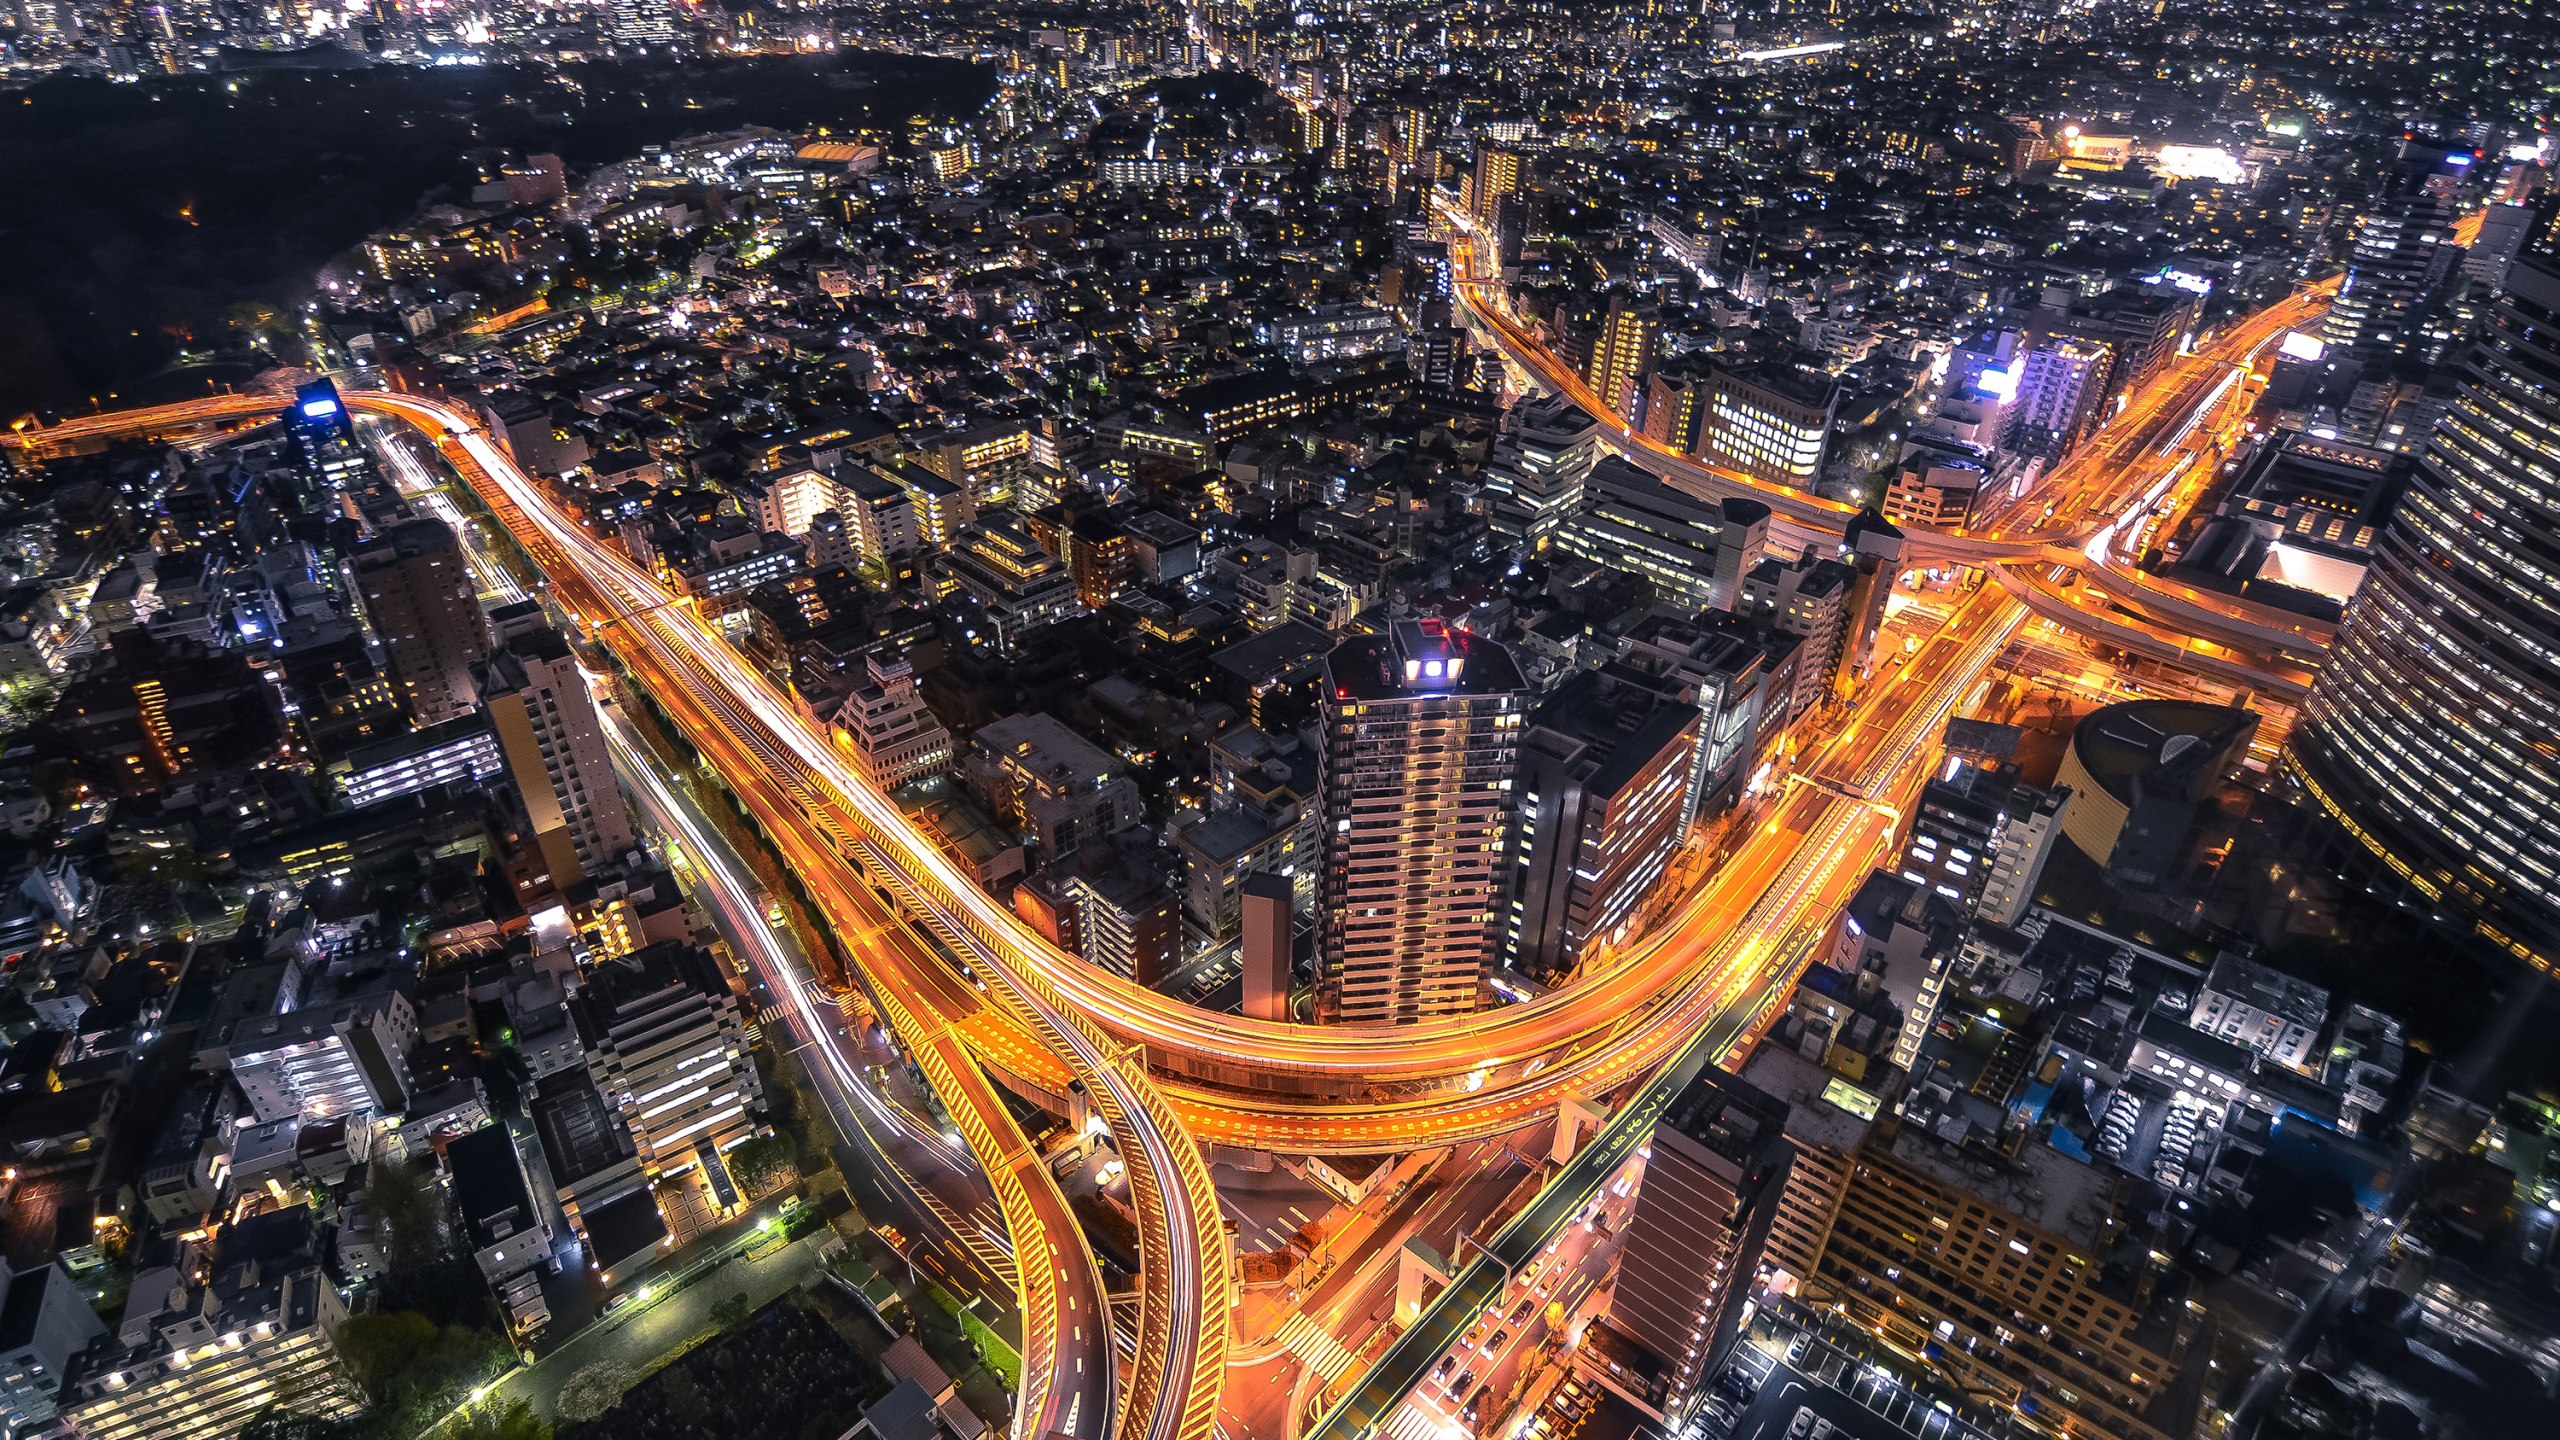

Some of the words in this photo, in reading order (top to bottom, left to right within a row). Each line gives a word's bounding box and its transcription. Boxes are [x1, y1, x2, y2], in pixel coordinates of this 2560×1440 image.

[1592, 1086, 1671, 1168] 速度おとせ
